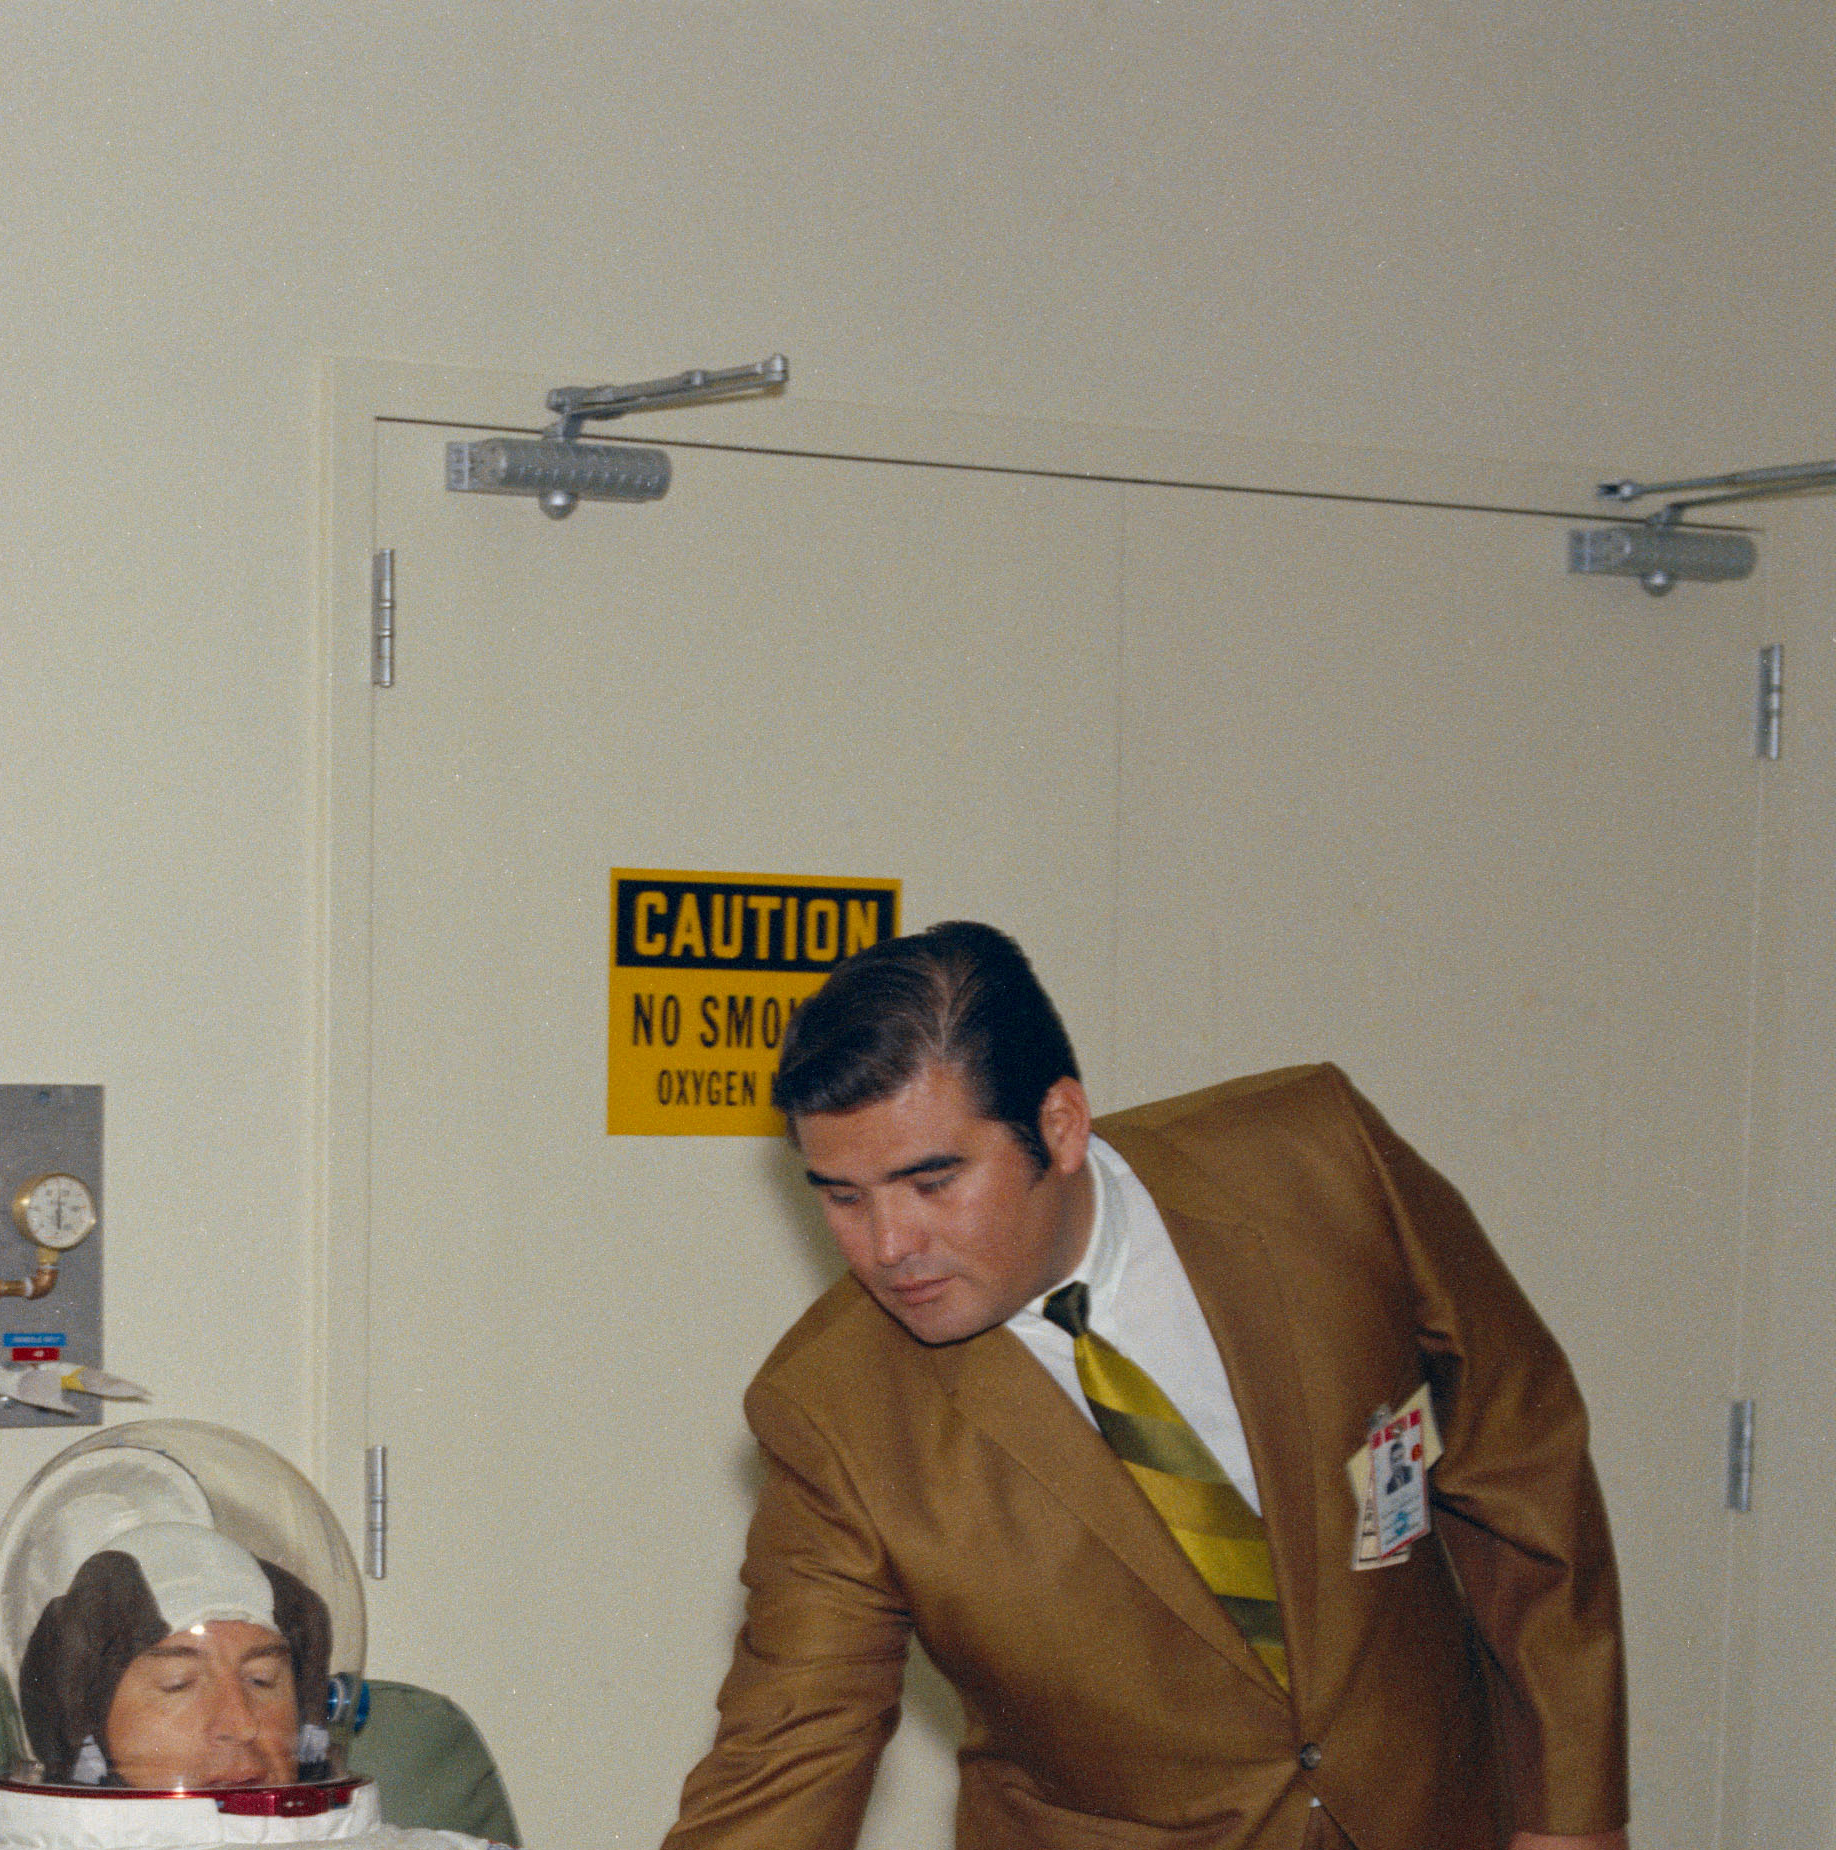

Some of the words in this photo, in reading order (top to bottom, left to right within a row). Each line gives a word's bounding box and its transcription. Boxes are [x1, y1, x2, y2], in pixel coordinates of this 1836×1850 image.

[634, 890, 879, 963] CAUTION
[632, 992, 680, 1047] NO
[700, 995, 804, 1049] SMO
[658, 1070, 757, 1106] OXYGEN
